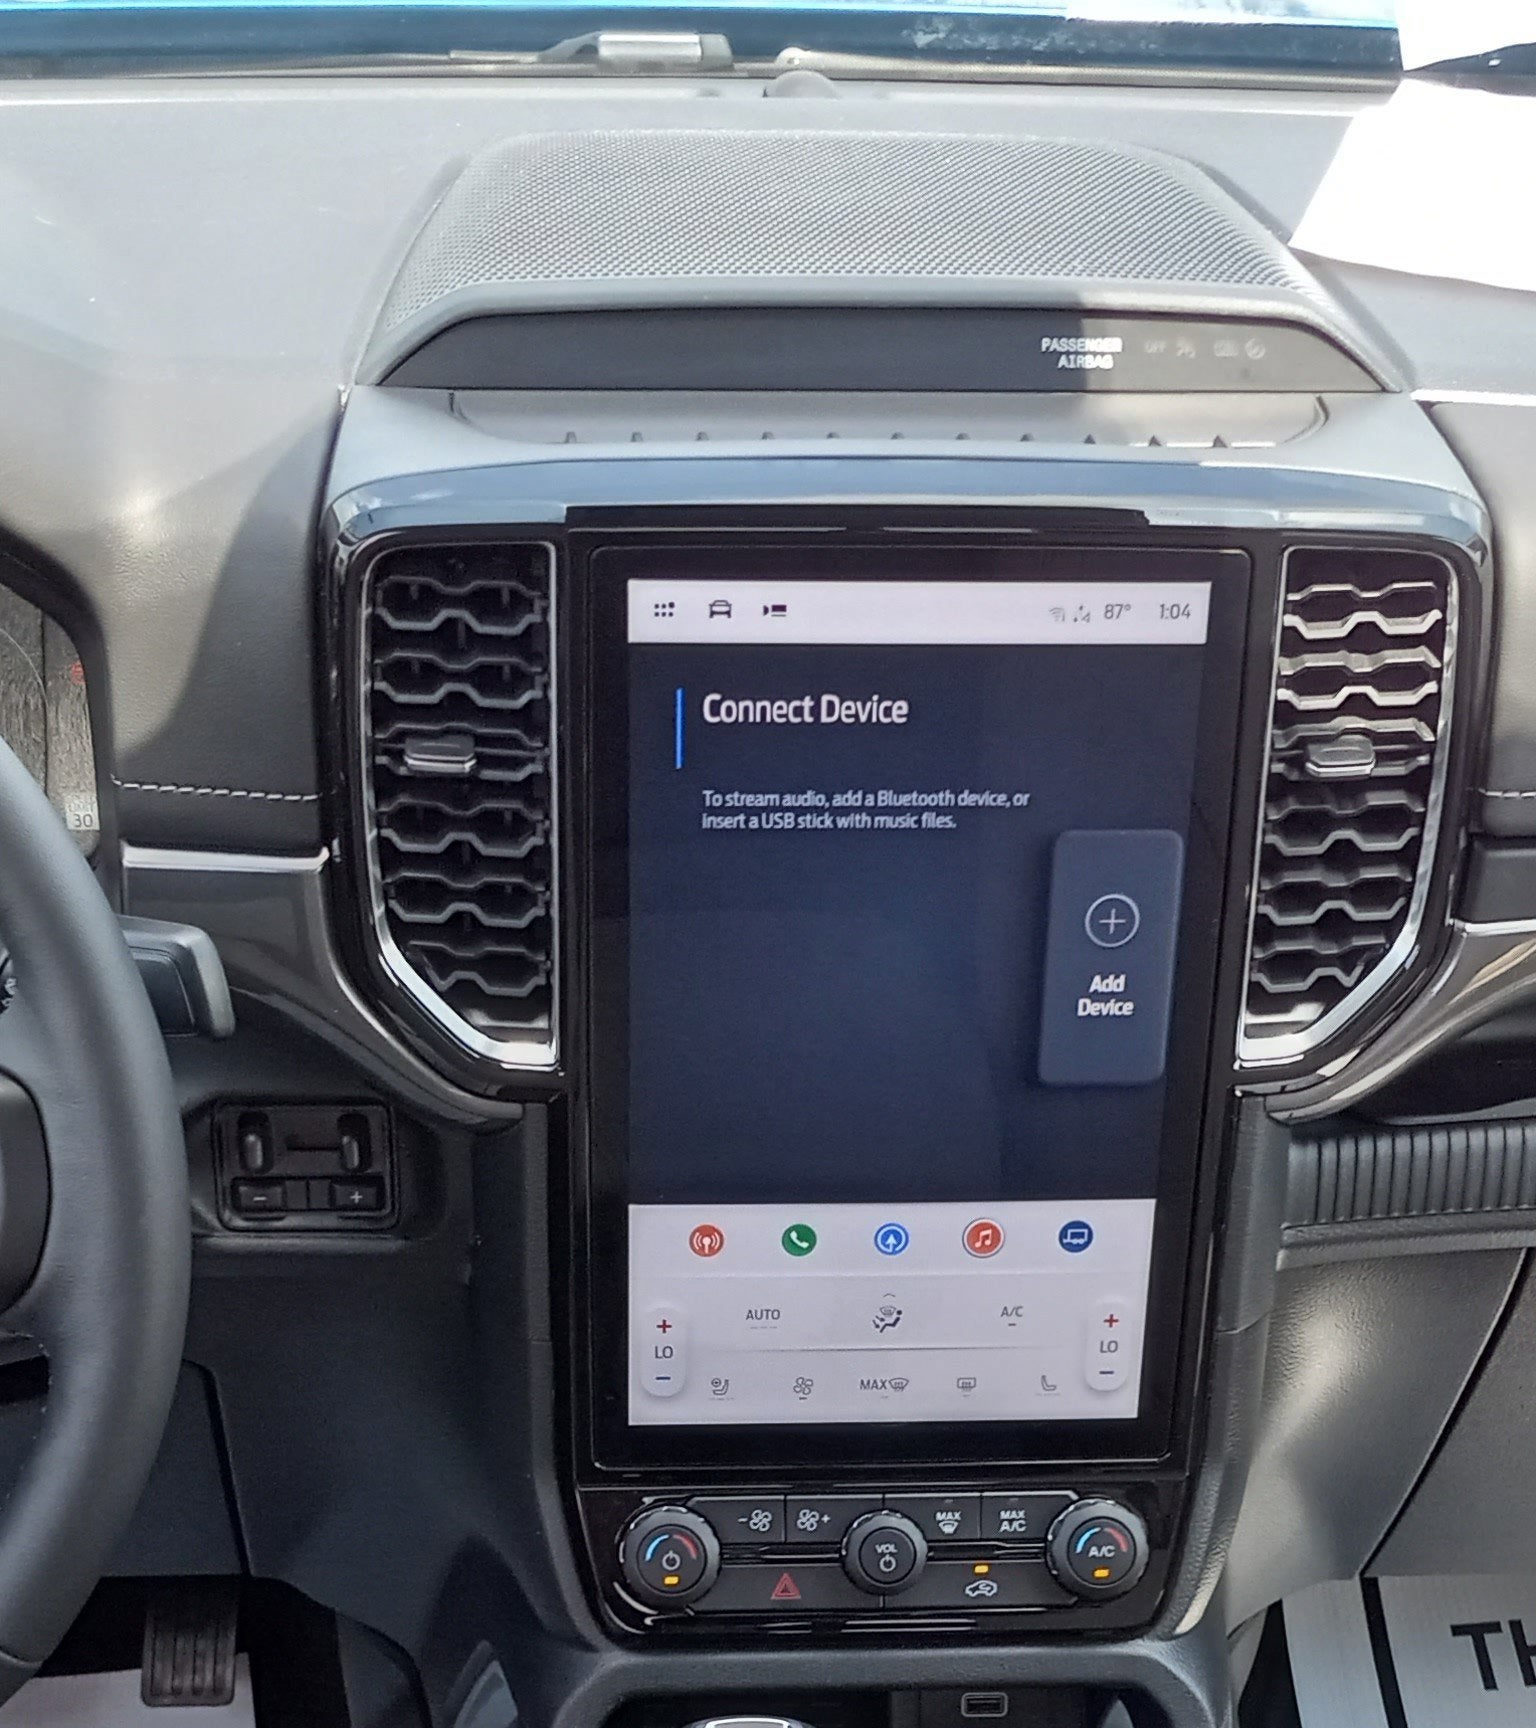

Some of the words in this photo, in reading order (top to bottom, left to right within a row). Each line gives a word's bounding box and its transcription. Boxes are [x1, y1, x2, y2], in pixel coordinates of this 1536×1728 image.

[1041, 337, 1123, 352] PASSENGER
[1058, 354, 1114, 369] AIRBAG
[1104, 602, 1131, 620] 87°
[1159, 603, 1192, 621] 1:04
[702, 693, 814, 726] Connect
[820, 693, 909, 726] Device
[702, 790, 723, 807] To
[724, 792, 780, 807] stream
[782, 789, 830, 809] audio,
[831, 789, 862, 807] add
[864, 794, 875, 807] a
[877, 789, 955, 807] Bluetooth
[956, 789, 1011, 809] device,
[1012, 794, 1031, 807] or
[73, 813, 94, 828] 30
[748, 815, 759, 829] a
[761, 812, 796, 829] USB
[796, 811, 834, 829] stick
[835, 811, 872, 829] with
[873, 811, 920, 829] music
[921, 811, 957, 829] files.
[1089, 974, 1126, 993] Add
[1077, 998, 1134, 1017] Device
[745, 1309, 781, 1323] AUTO
[1000, 1305, 1024, 1320] A/C
[654, 1346, 673, 1360] LO
[1099, 1340, 1119, 1354] LO
[860, 1378, 888, 1392] MAX
[935, 1511, 961, 1521] MAX
[999, 1510, 1026, 1520] MAX
[999, 1520, 1026, 1532] A/C
[875, 1543, 898, 1554] VOL
[1088, 1545, 1115, 1558] A/C
